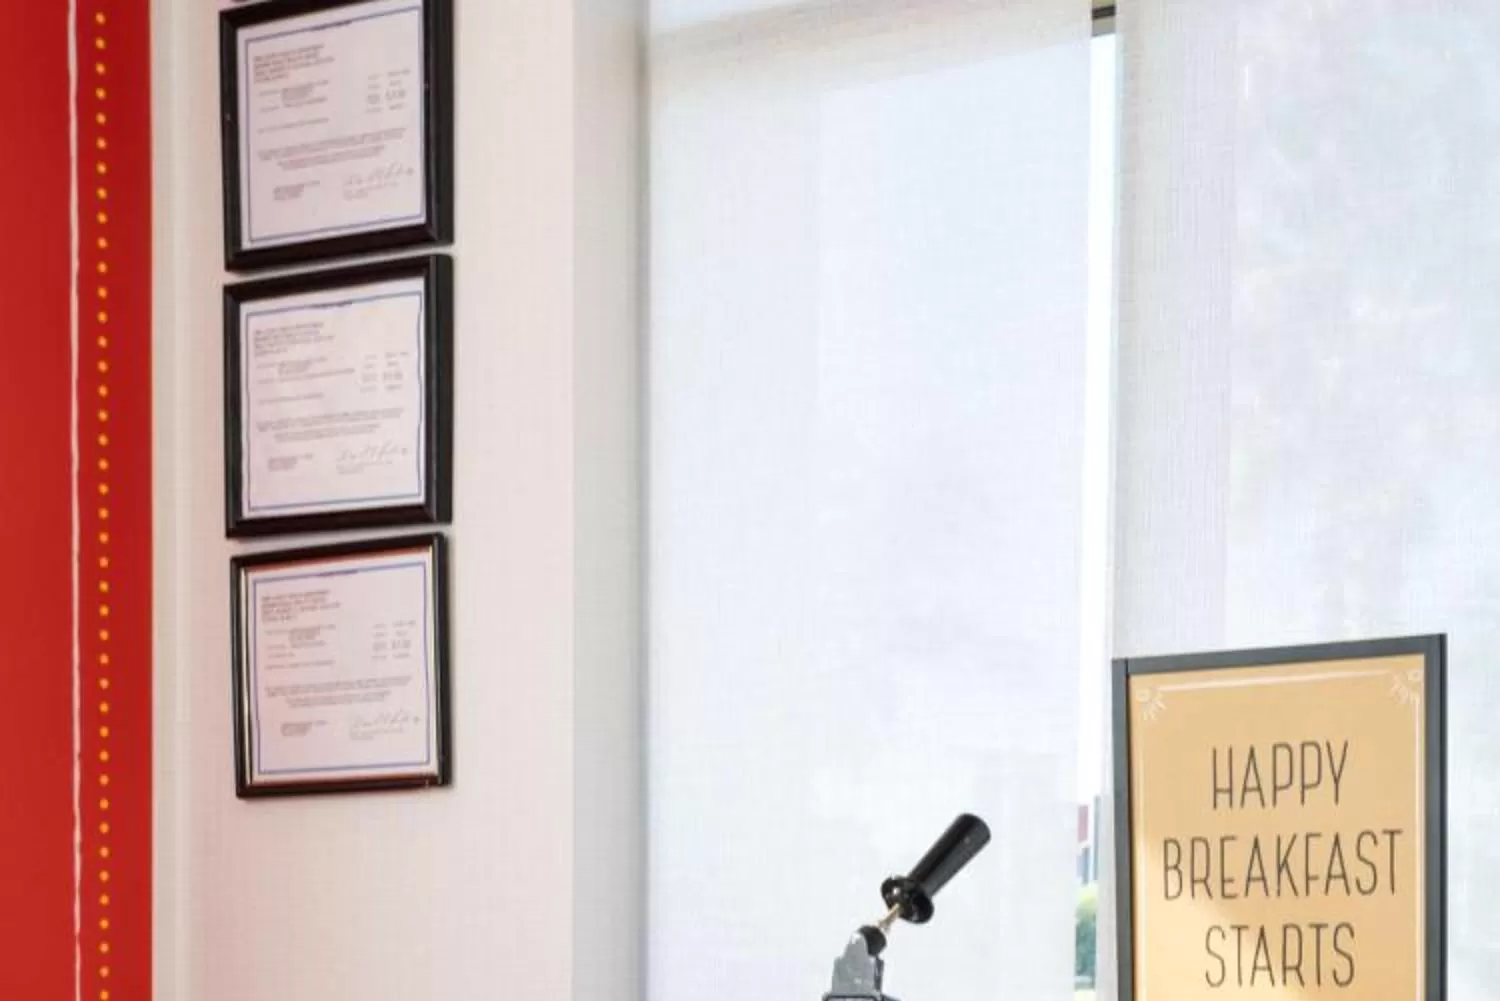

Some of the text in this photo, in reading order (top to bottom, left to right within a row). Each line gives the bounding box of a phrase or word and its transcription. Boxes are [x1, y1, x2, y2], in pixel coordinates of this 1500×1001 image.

[1211, 739, 1349, 810] HAPPY
[1163, 829, 1404, 901] BREAKFAST
[1205, 921, 1356, 988] STARTS
